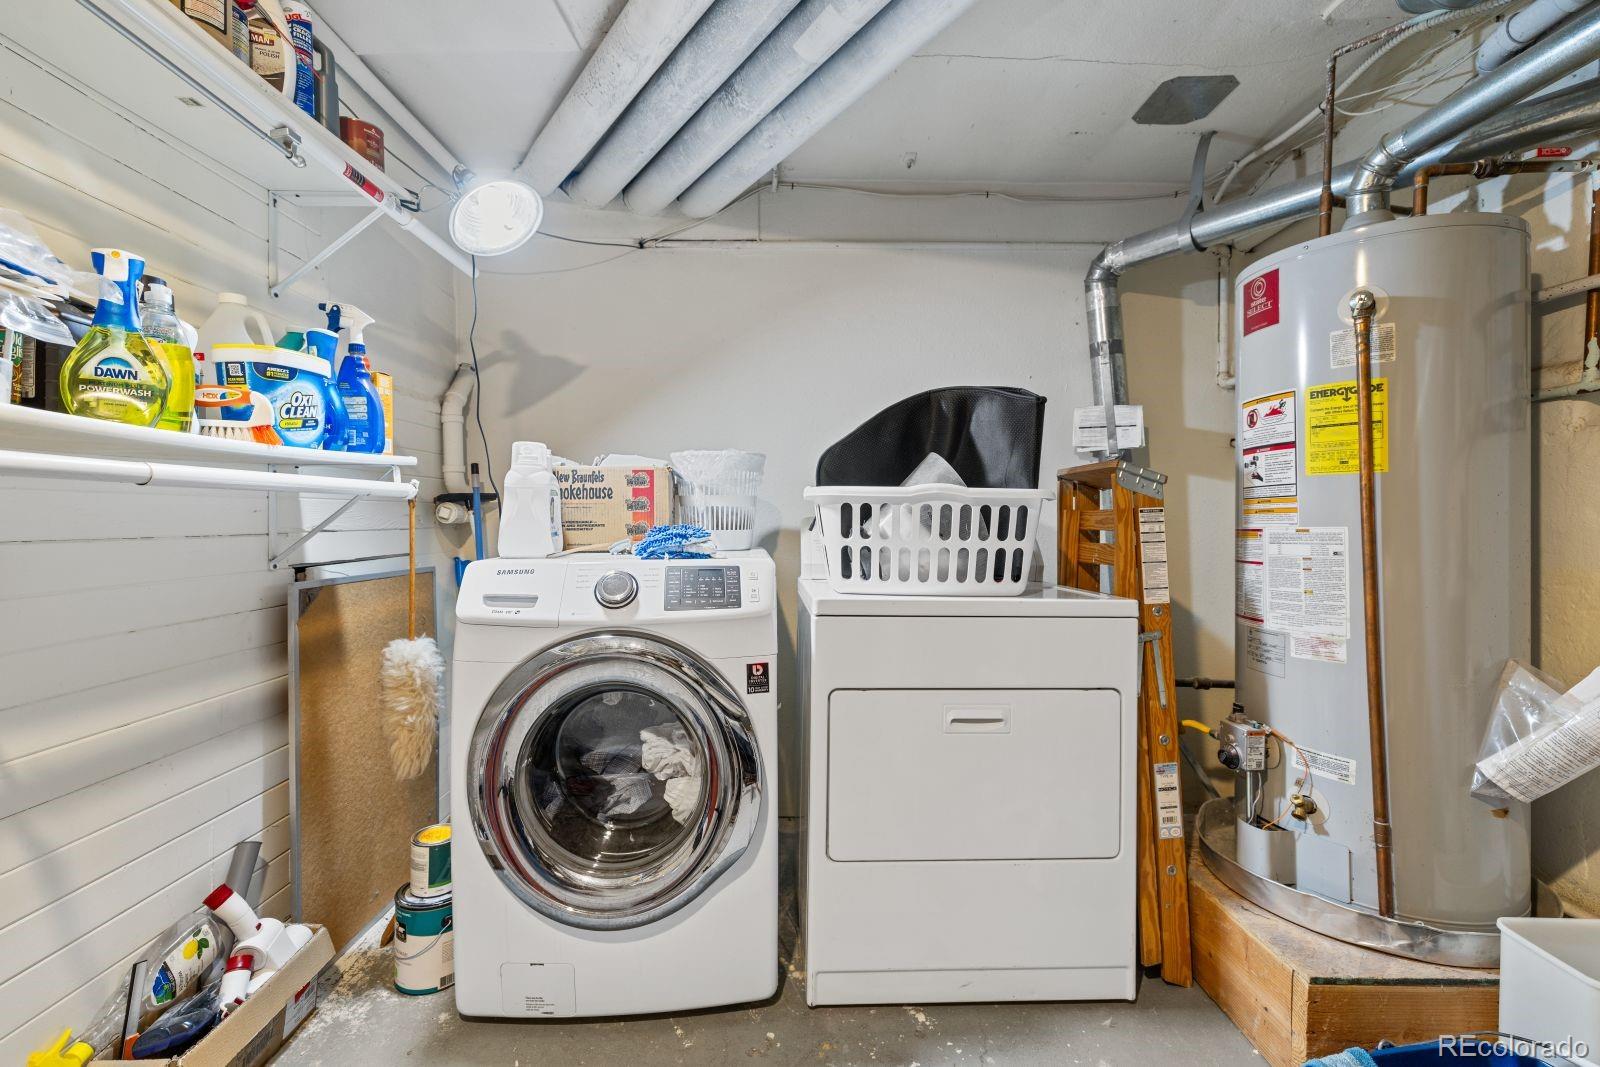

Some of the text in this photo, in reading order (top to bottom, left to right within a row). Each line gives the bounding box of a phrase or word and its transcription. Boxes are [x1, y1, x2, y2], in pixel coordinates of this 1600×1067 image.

[259, 51, 280, 59] POLISH
[94, 366, 138, 380] DAWN
[78, 384, 152, 397] POWERWASH
[290, 390, 314, 407] OXI
[279, 402, 317, 419] CLEAN
[572, 469, 605, 484] Braunfels
[560, 484, 614, 500] okehouse
[496, 568, 535, 576] SAMSUNG
